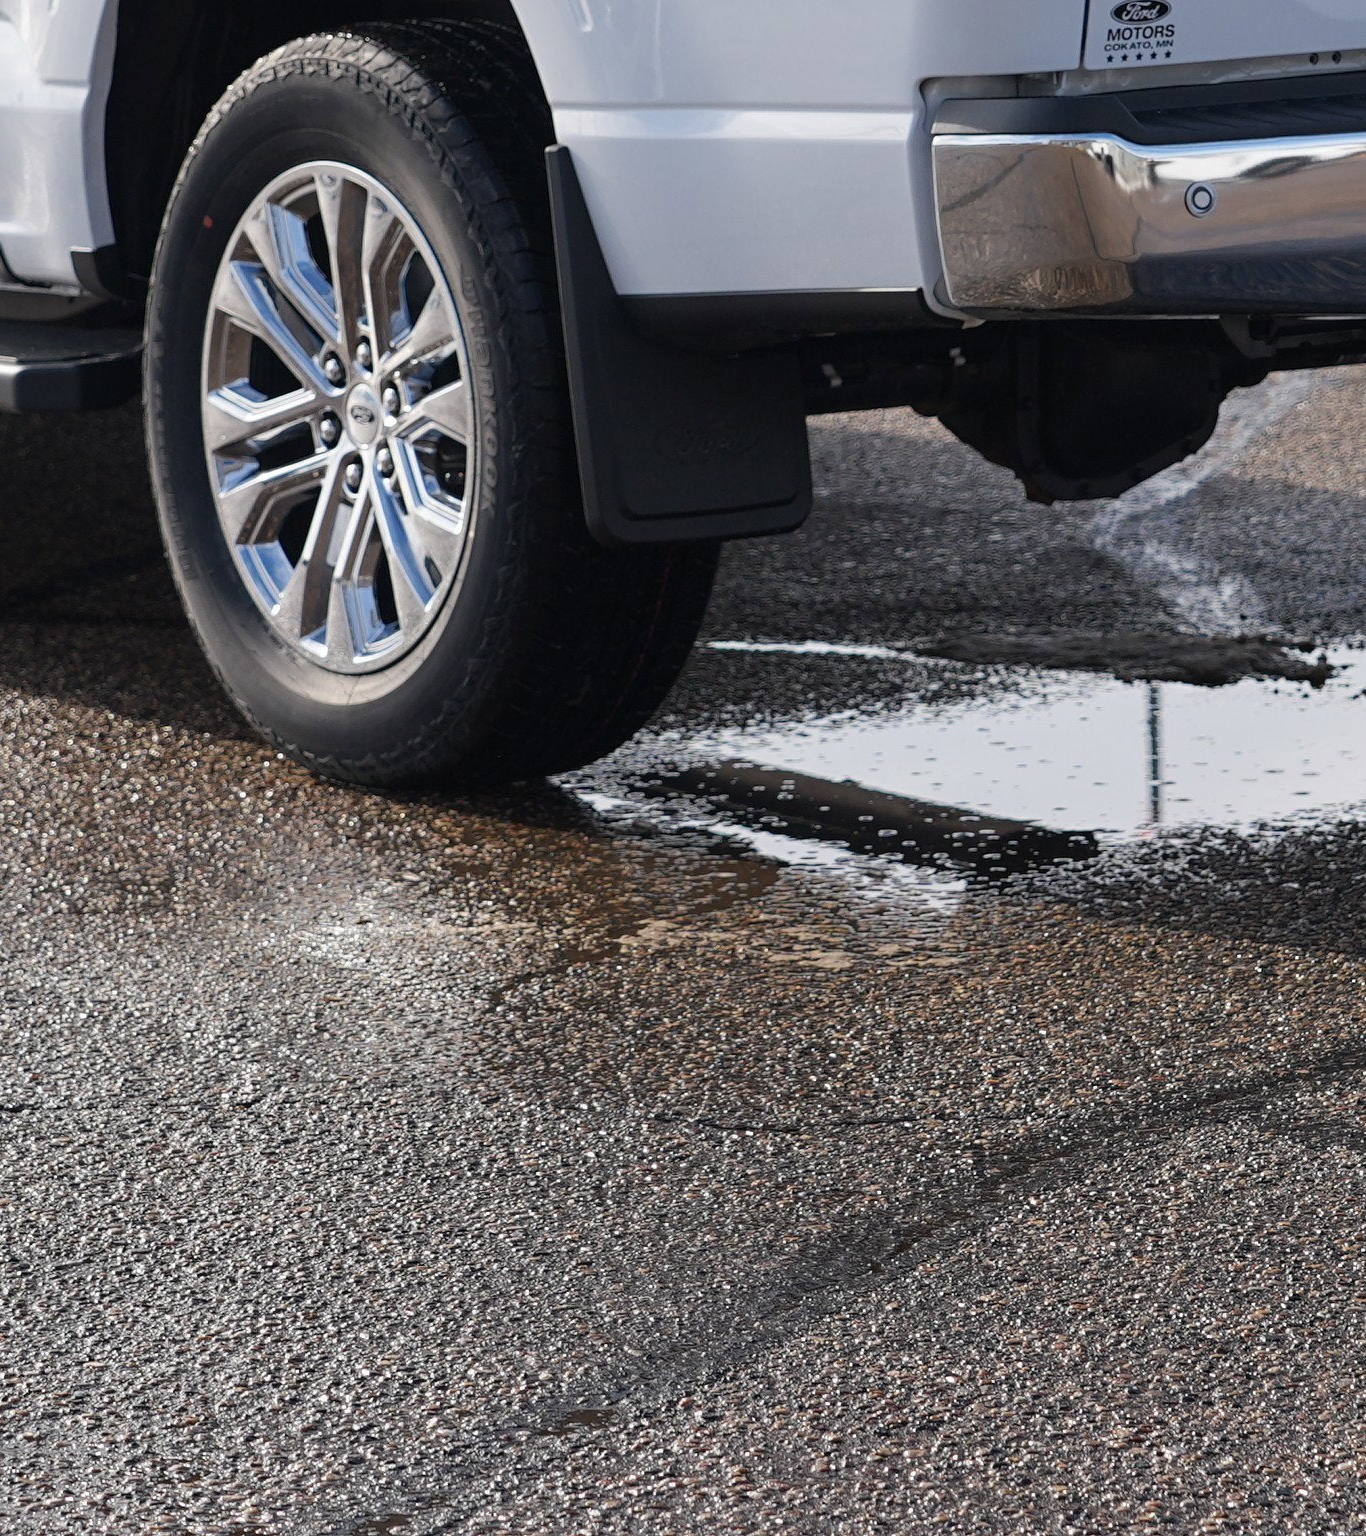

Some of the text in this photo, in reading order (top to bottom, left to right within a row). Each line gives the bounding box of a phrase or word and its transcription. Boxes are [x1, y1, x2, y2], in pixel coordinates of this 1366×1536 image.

[1121, 0, 1161, 22] Ford
[1107, 25, 1175, 41] MOTORS
[1104, 40, 1173, 52] COKATO, MN
